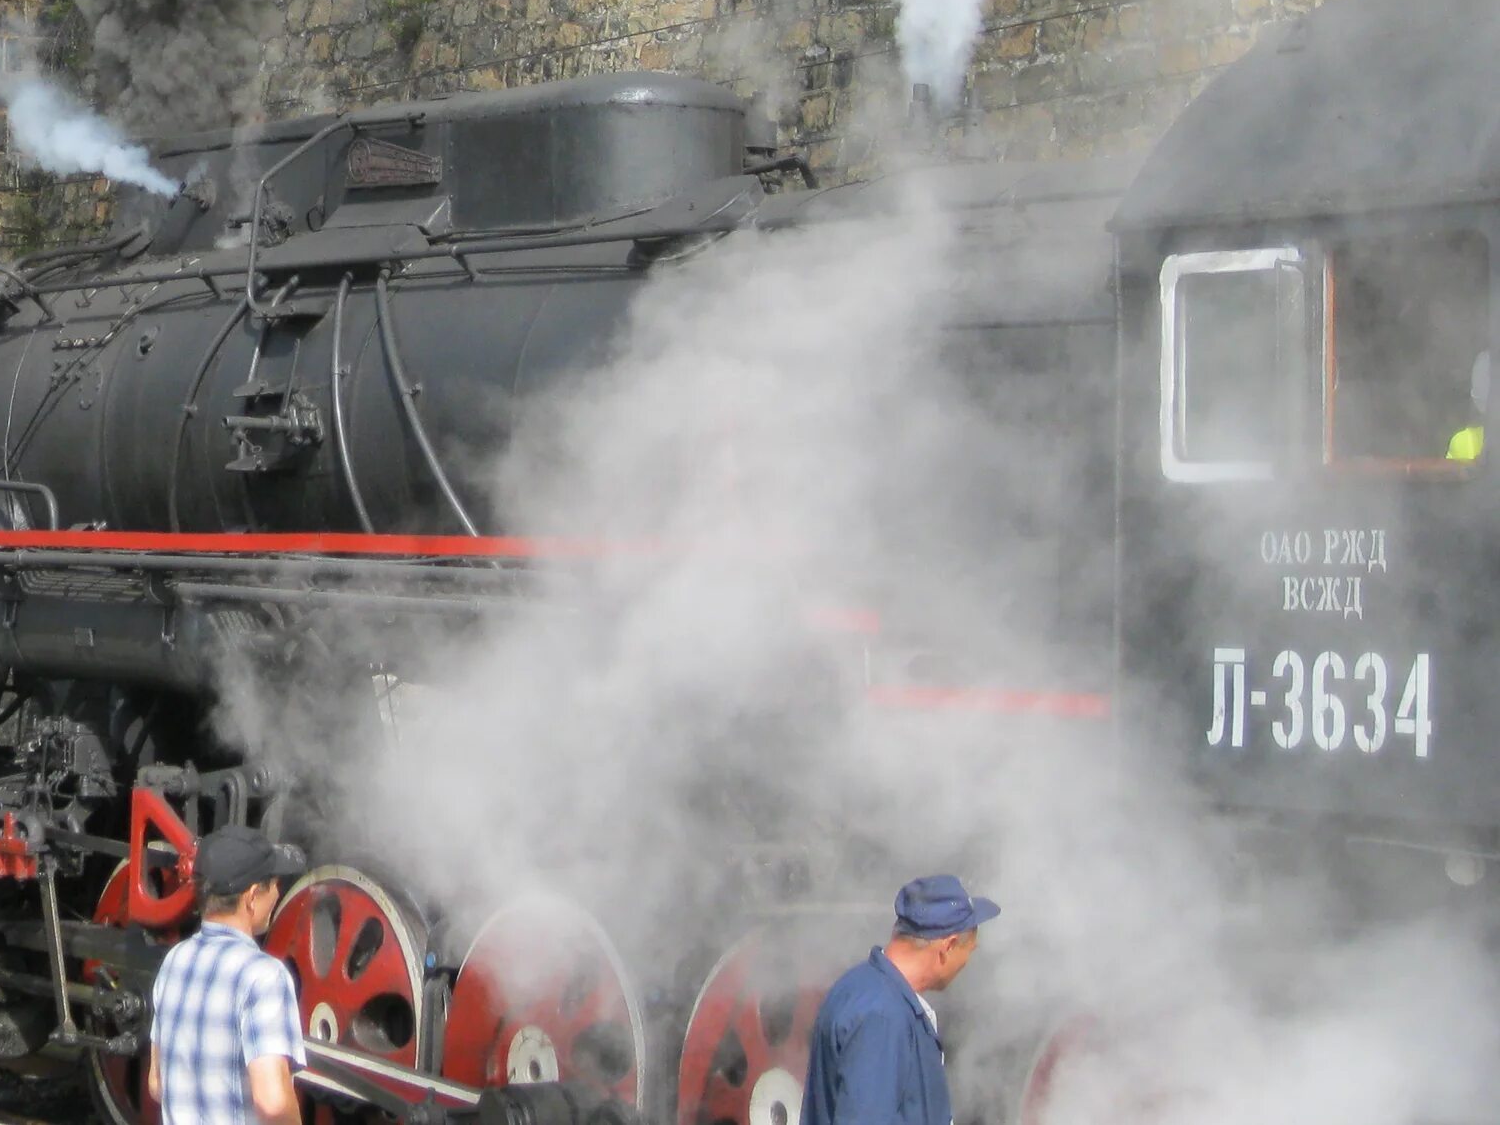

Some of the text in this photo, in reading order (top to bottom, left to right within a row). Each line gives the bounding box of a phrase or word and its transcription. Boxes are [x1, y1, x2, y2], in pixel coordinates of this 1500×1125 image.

[1260, 530, 1386, 573] ОАО РЖД
[1282, 576, 1362, 619] ВСЖД
[1206, 648, 1431, 757] Л-3634
